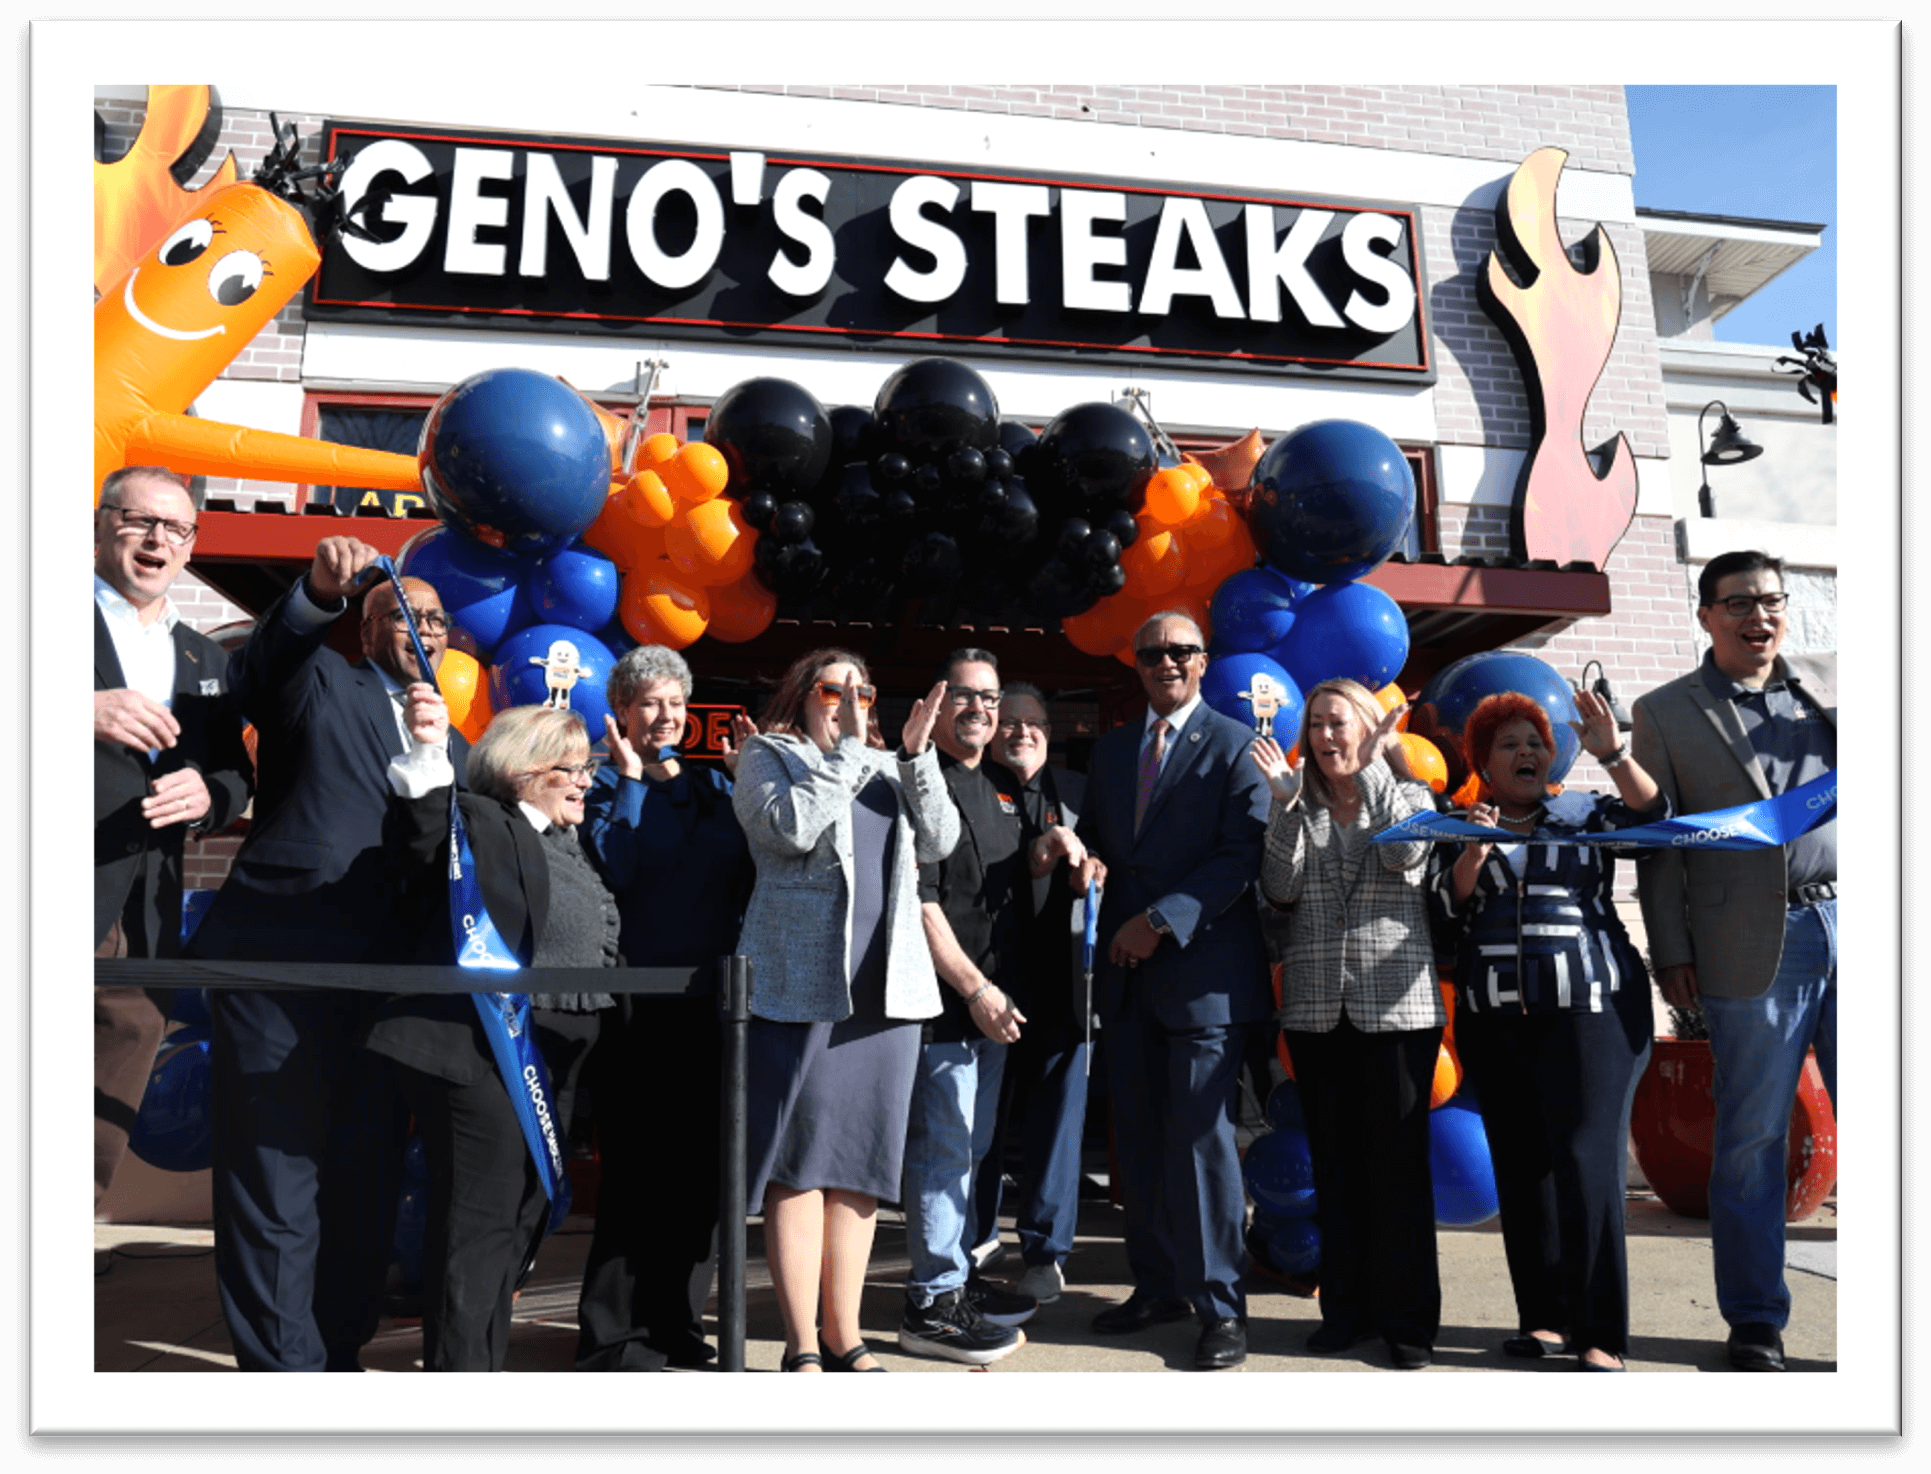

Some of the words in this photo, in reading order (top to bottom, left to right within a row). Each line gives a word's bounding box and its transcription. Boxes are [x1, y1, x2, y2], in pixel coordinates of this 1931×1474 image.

[338, 139, 835, 297] GENO'S
[883, 175, 1416, 333] STEAKS
[1671, 823, 1738, 846] CHOOSE
